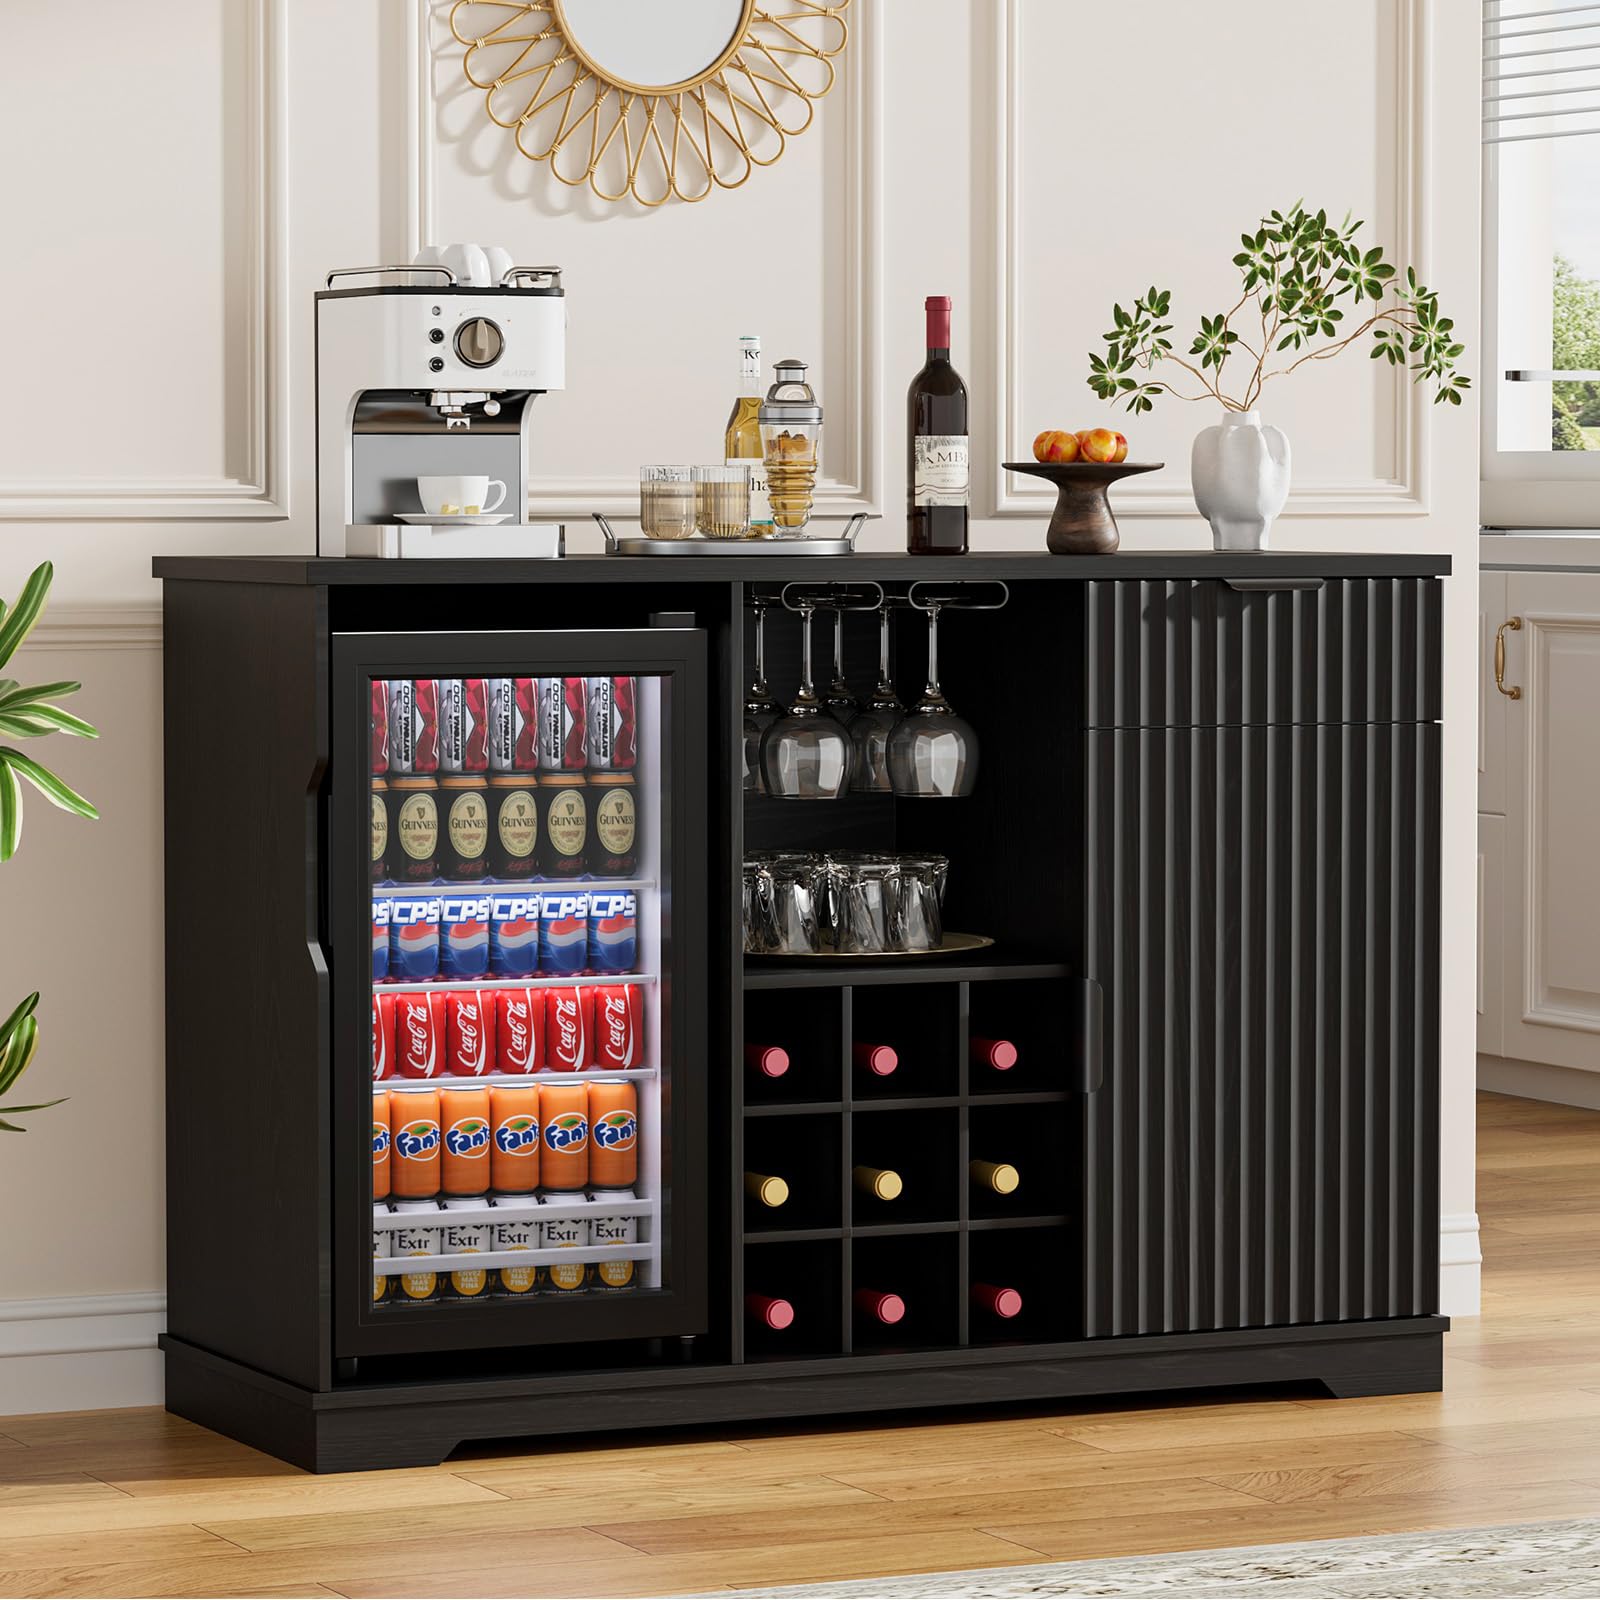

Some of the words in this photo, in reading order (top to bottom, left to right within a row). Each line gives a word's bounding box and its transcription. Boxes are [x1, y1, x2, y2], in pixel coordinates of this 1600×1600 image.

[498, 1228, 529, 1243] Extr
[547, 1226, 578, 1241] Extr
[596, 1223, 627, 1238] Extr
[398, 1234, 430, 1249] Extr
[448, 1231, 480, 1246] Extr
